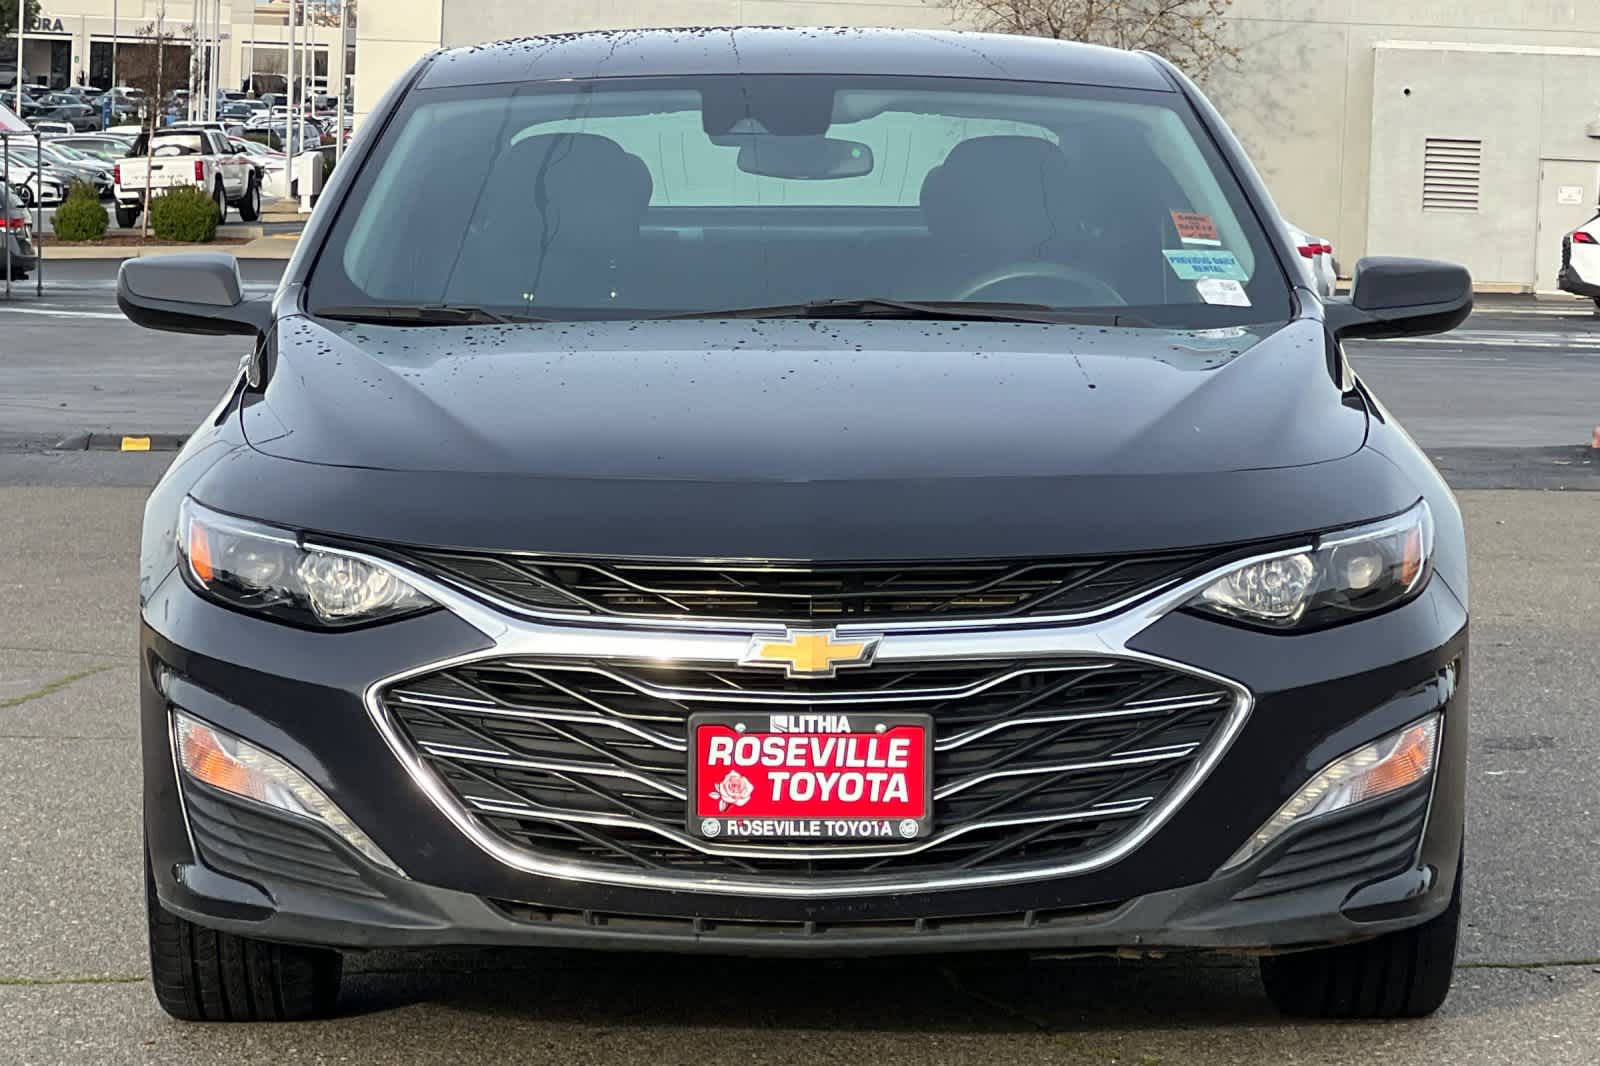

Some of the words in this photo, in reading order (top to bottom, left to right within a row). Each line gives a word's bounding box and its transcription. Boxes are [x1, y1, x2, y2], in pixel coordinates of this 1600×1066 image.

[788, 715, 850, 733] LITHIA
[708, 736, 911, 768] ROSEVILLE
[768, 772, 909, 802] TOYOTA
[727, 820, 821, 836] ROSEVILLE
[824, 820, 893, 837] TOYOTA
